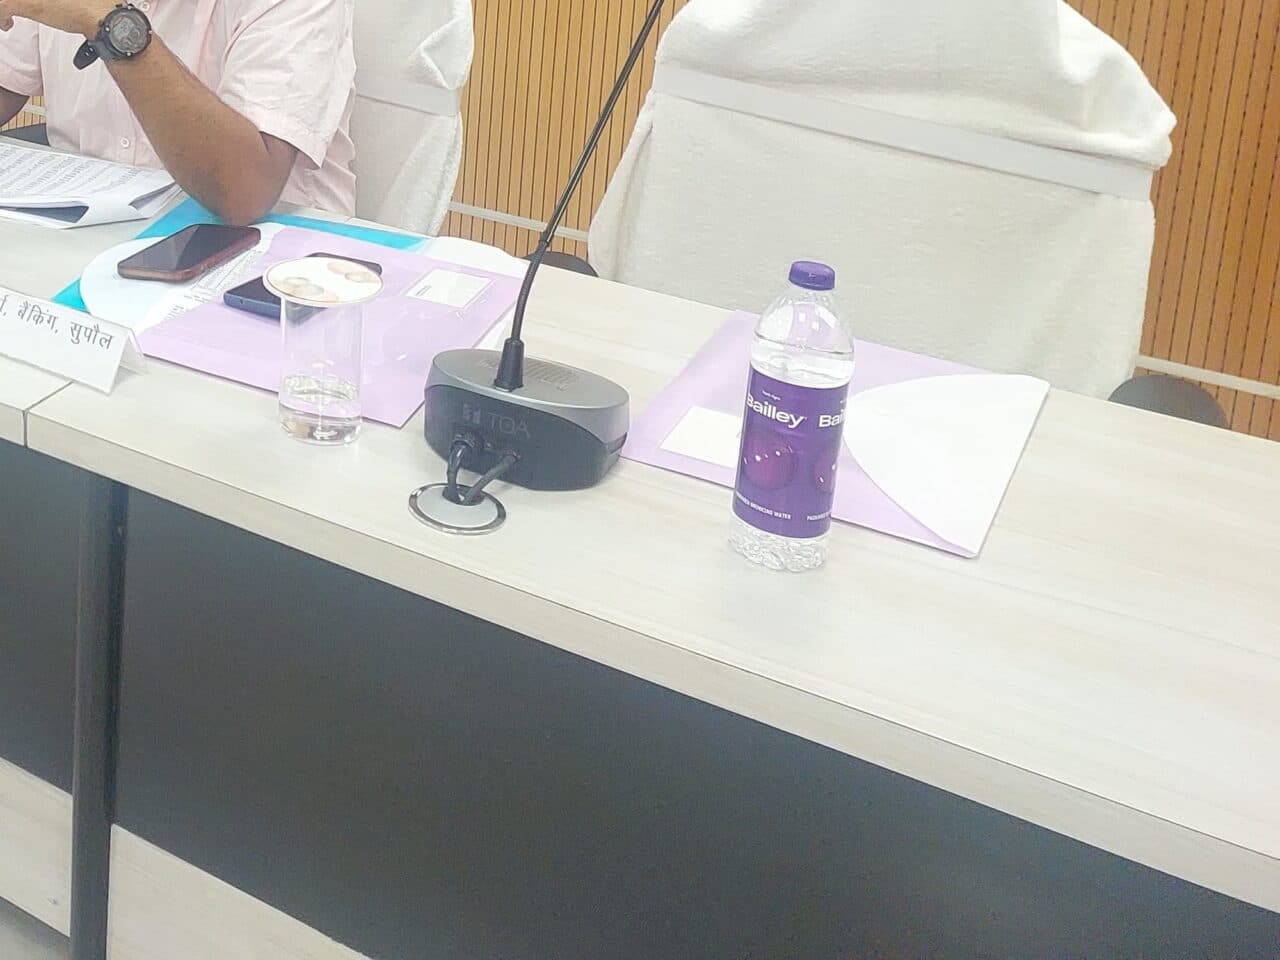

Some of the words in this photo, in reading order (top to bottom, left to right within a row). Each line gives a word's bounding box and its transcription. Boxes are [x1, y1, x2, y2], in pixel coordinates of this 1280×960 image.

[69, 322, 115, 350] सुपौल
[487, 411, 531, 439] TOA
[746, 393, 805, 429] Bailley
